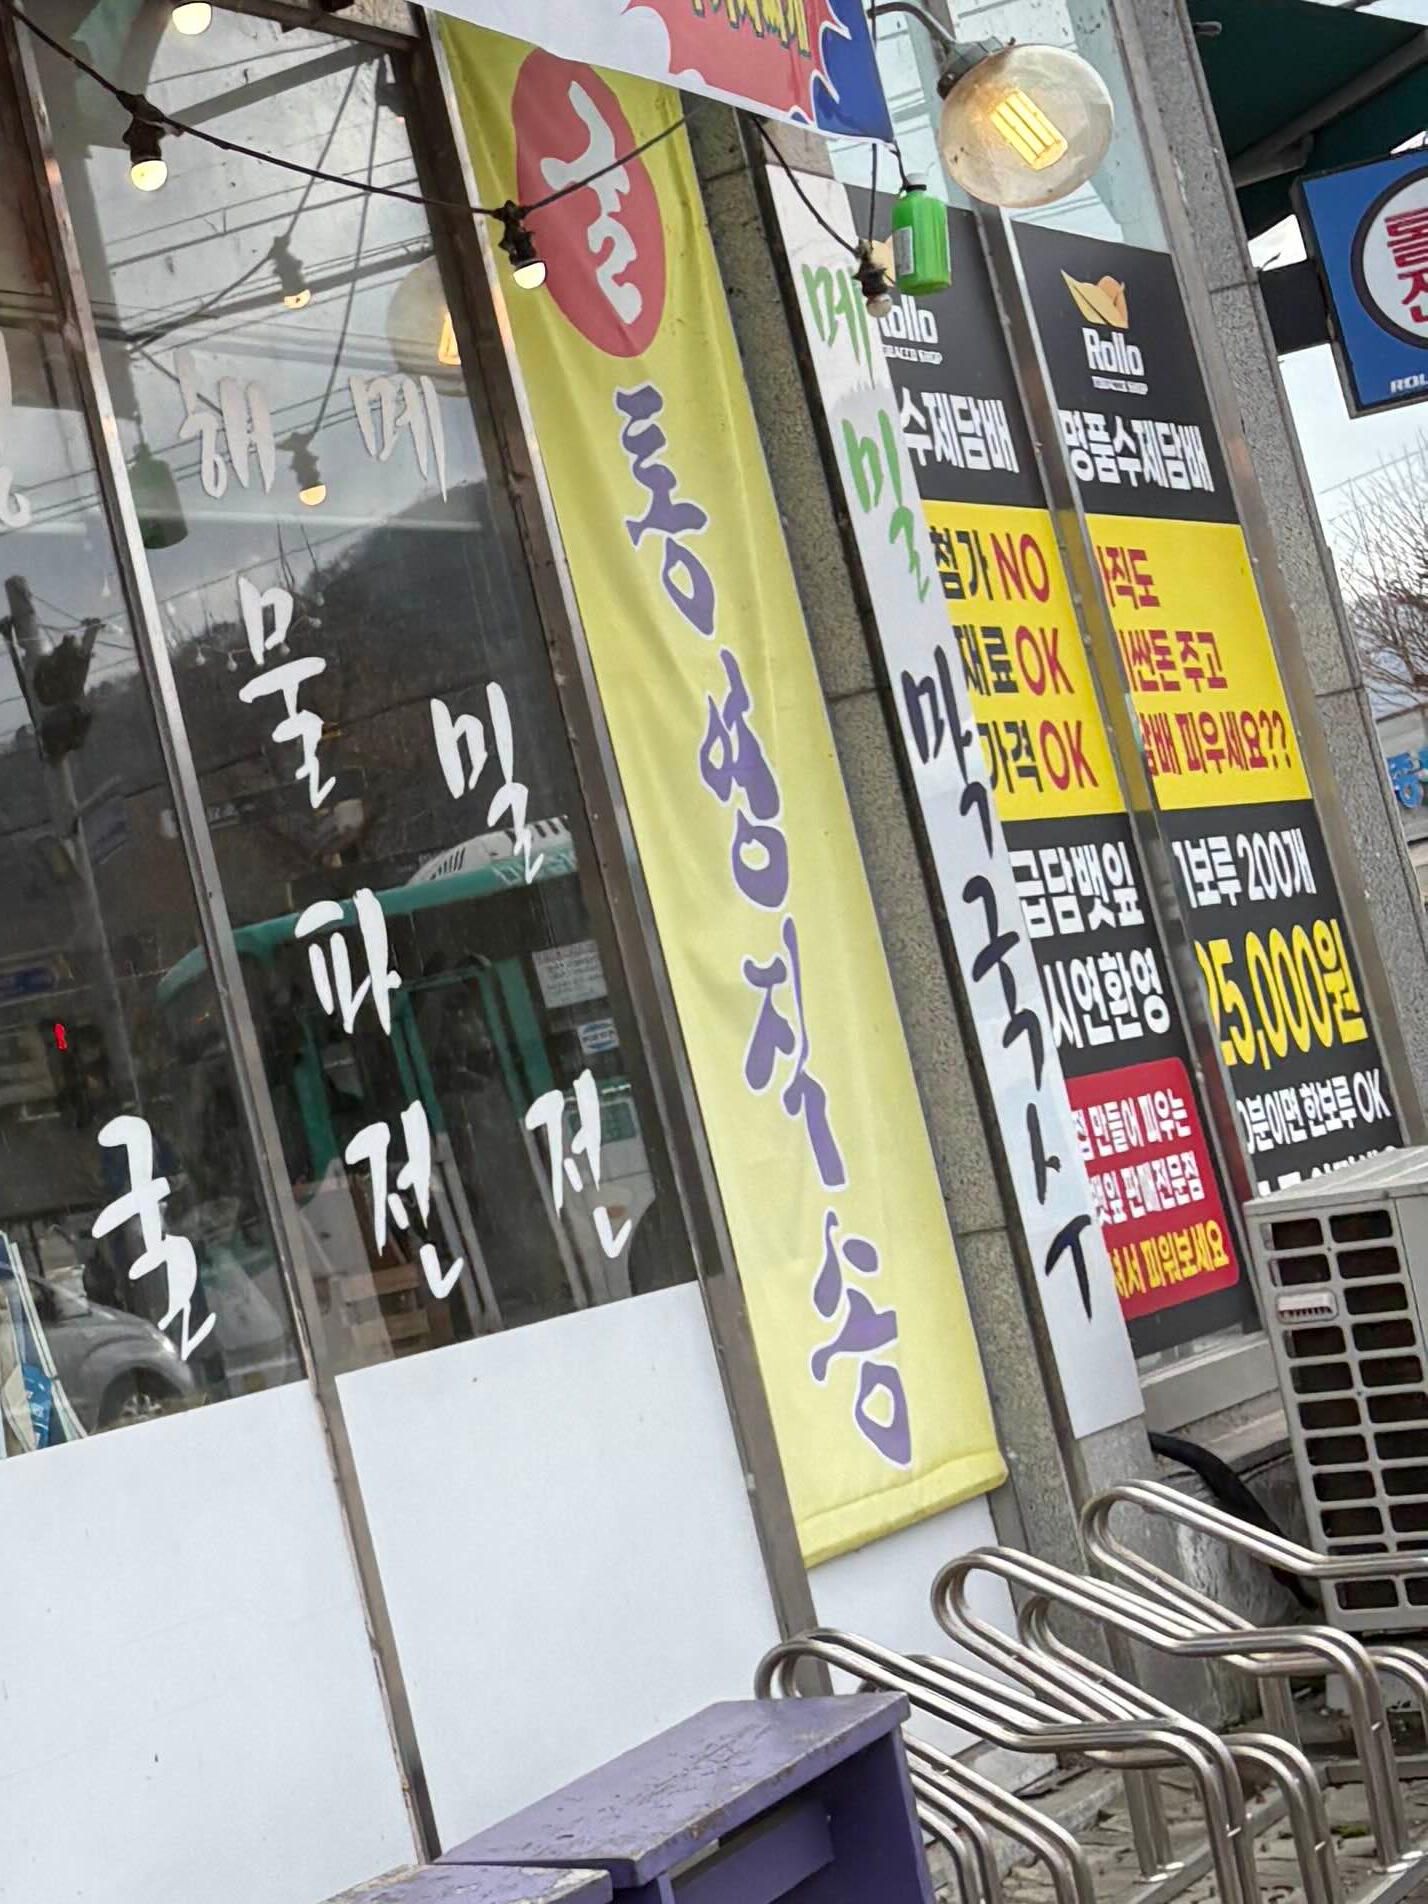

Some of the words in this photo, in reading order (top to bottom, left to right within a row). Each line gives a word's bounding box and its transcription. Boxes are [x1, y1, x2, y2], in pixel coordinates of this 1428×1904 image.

[1082, 326, 1145, 377] Rollo
[899, 386, 1020, 474] 수제담배
[1058, 408, 1215, 493] 명품수제담배
[990, 532, 1051, 604] NO
[1015, 624, 1076, 696] OK
[1175, 630, 1229, 694] 주고
[539, 81, 643, 327] 굴
[613, 385, 914, 1469] 통영직송
[1039, 718, 1099, 791] OK
[1235, 827, 1317, 901] 200개
[1300, 1075, 1358, 1139] 한보루
[1353, 1068, 1392, 1125] OK
[1140, 1219, 1230, 1289] 피워보세요
